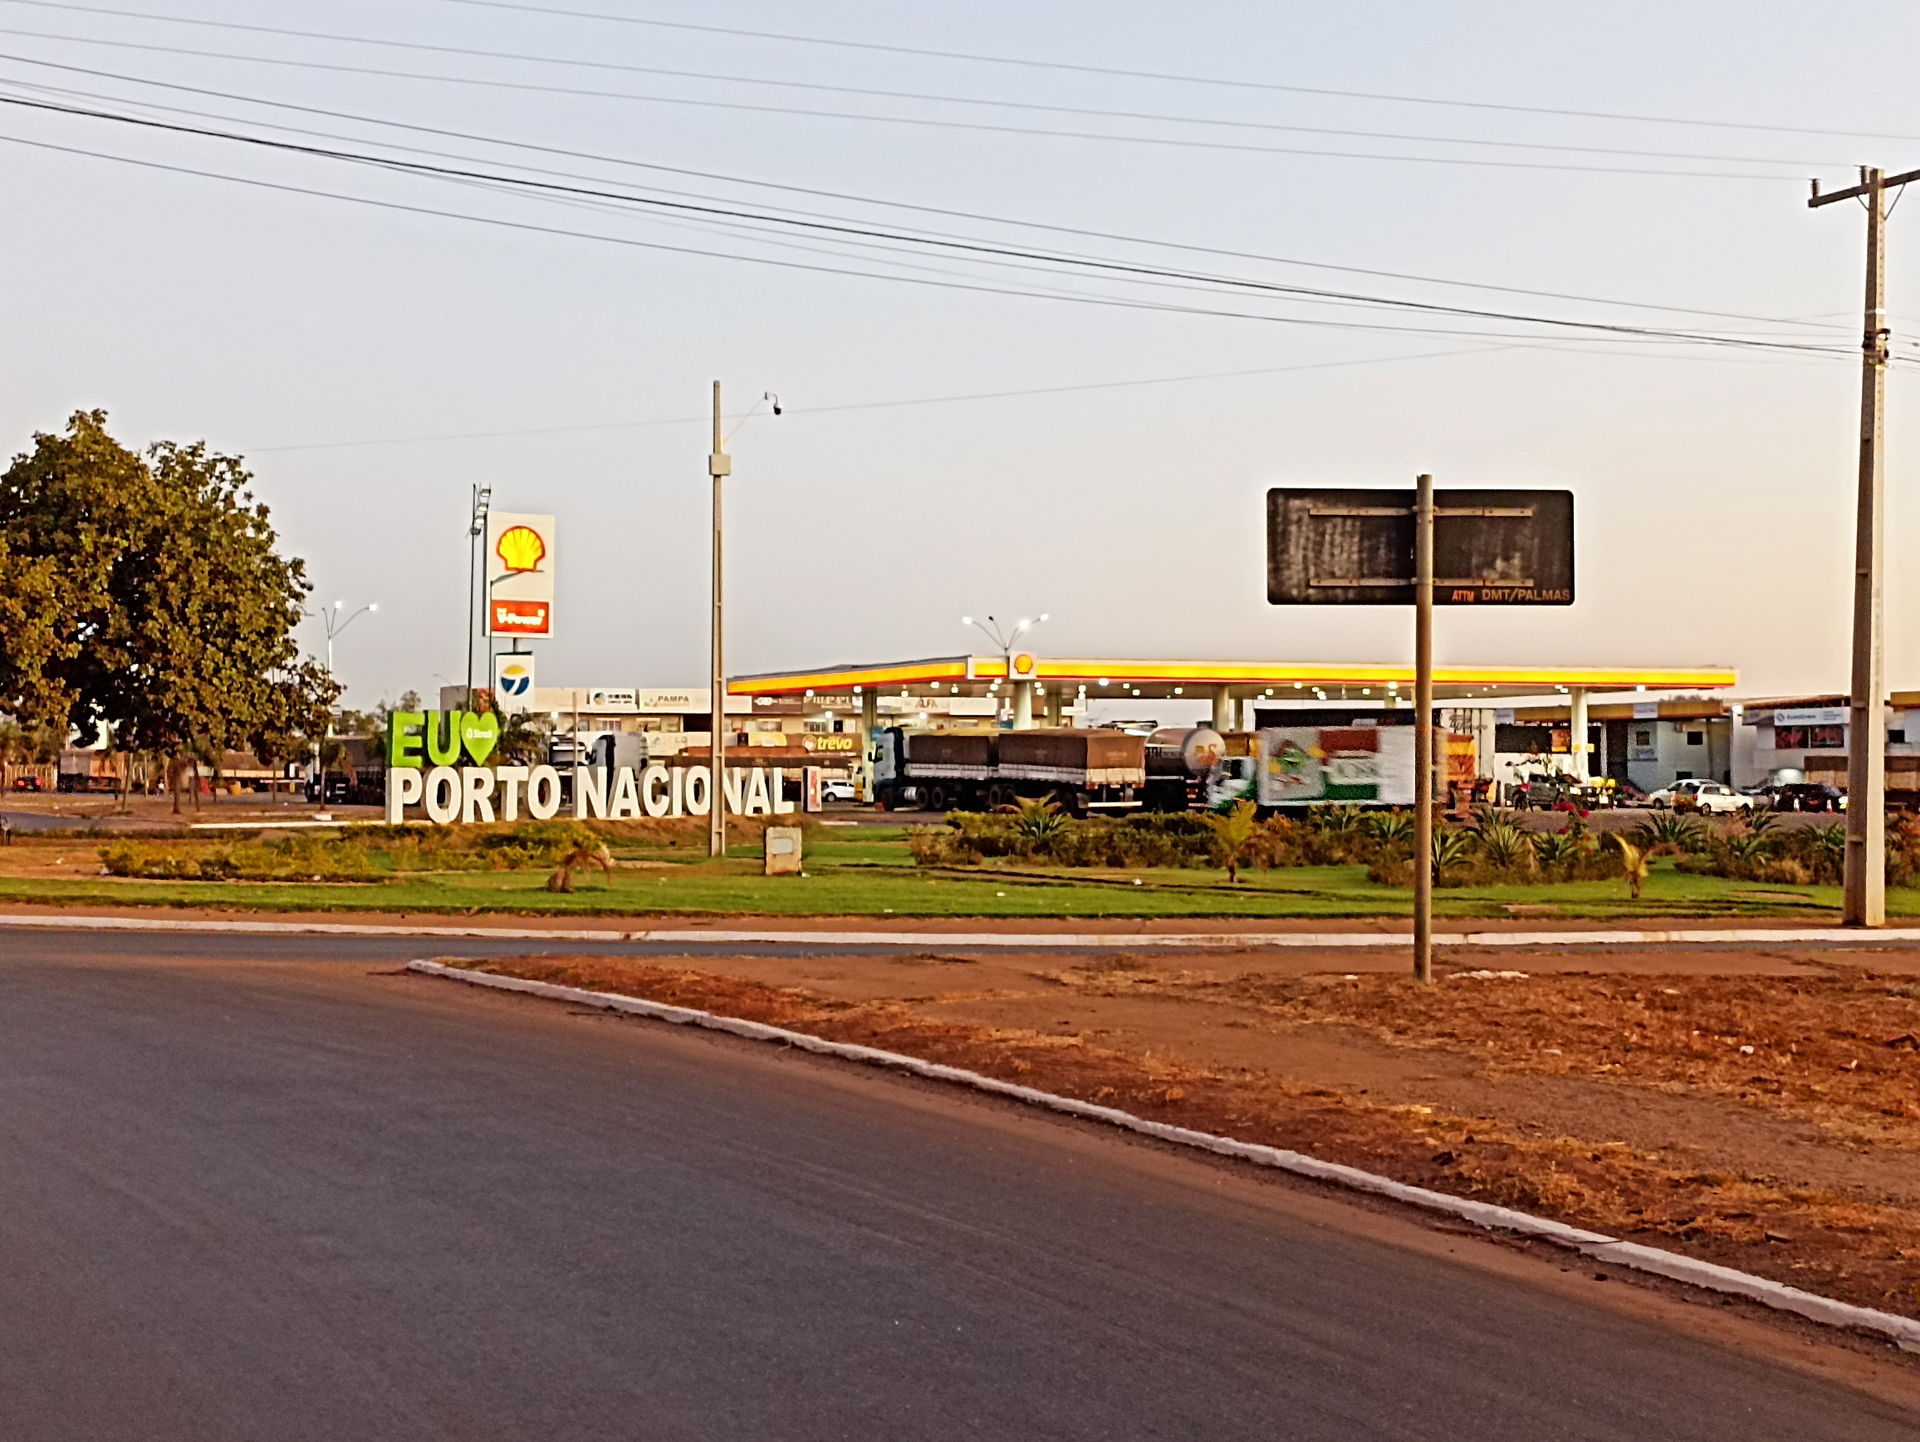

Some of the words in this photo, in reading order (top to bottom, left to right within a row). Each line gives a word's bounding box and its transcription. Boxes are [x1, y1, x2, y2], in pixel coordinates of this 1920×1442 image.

[1481, 588, 1571, 602] DMT/PALMAS
[915, 699, 938, 708] ALFA
[387, 710, 461, 769] EU
[386, 764, 562, 825] PORTO
[574, 765, 795, 819] NACIONAL
